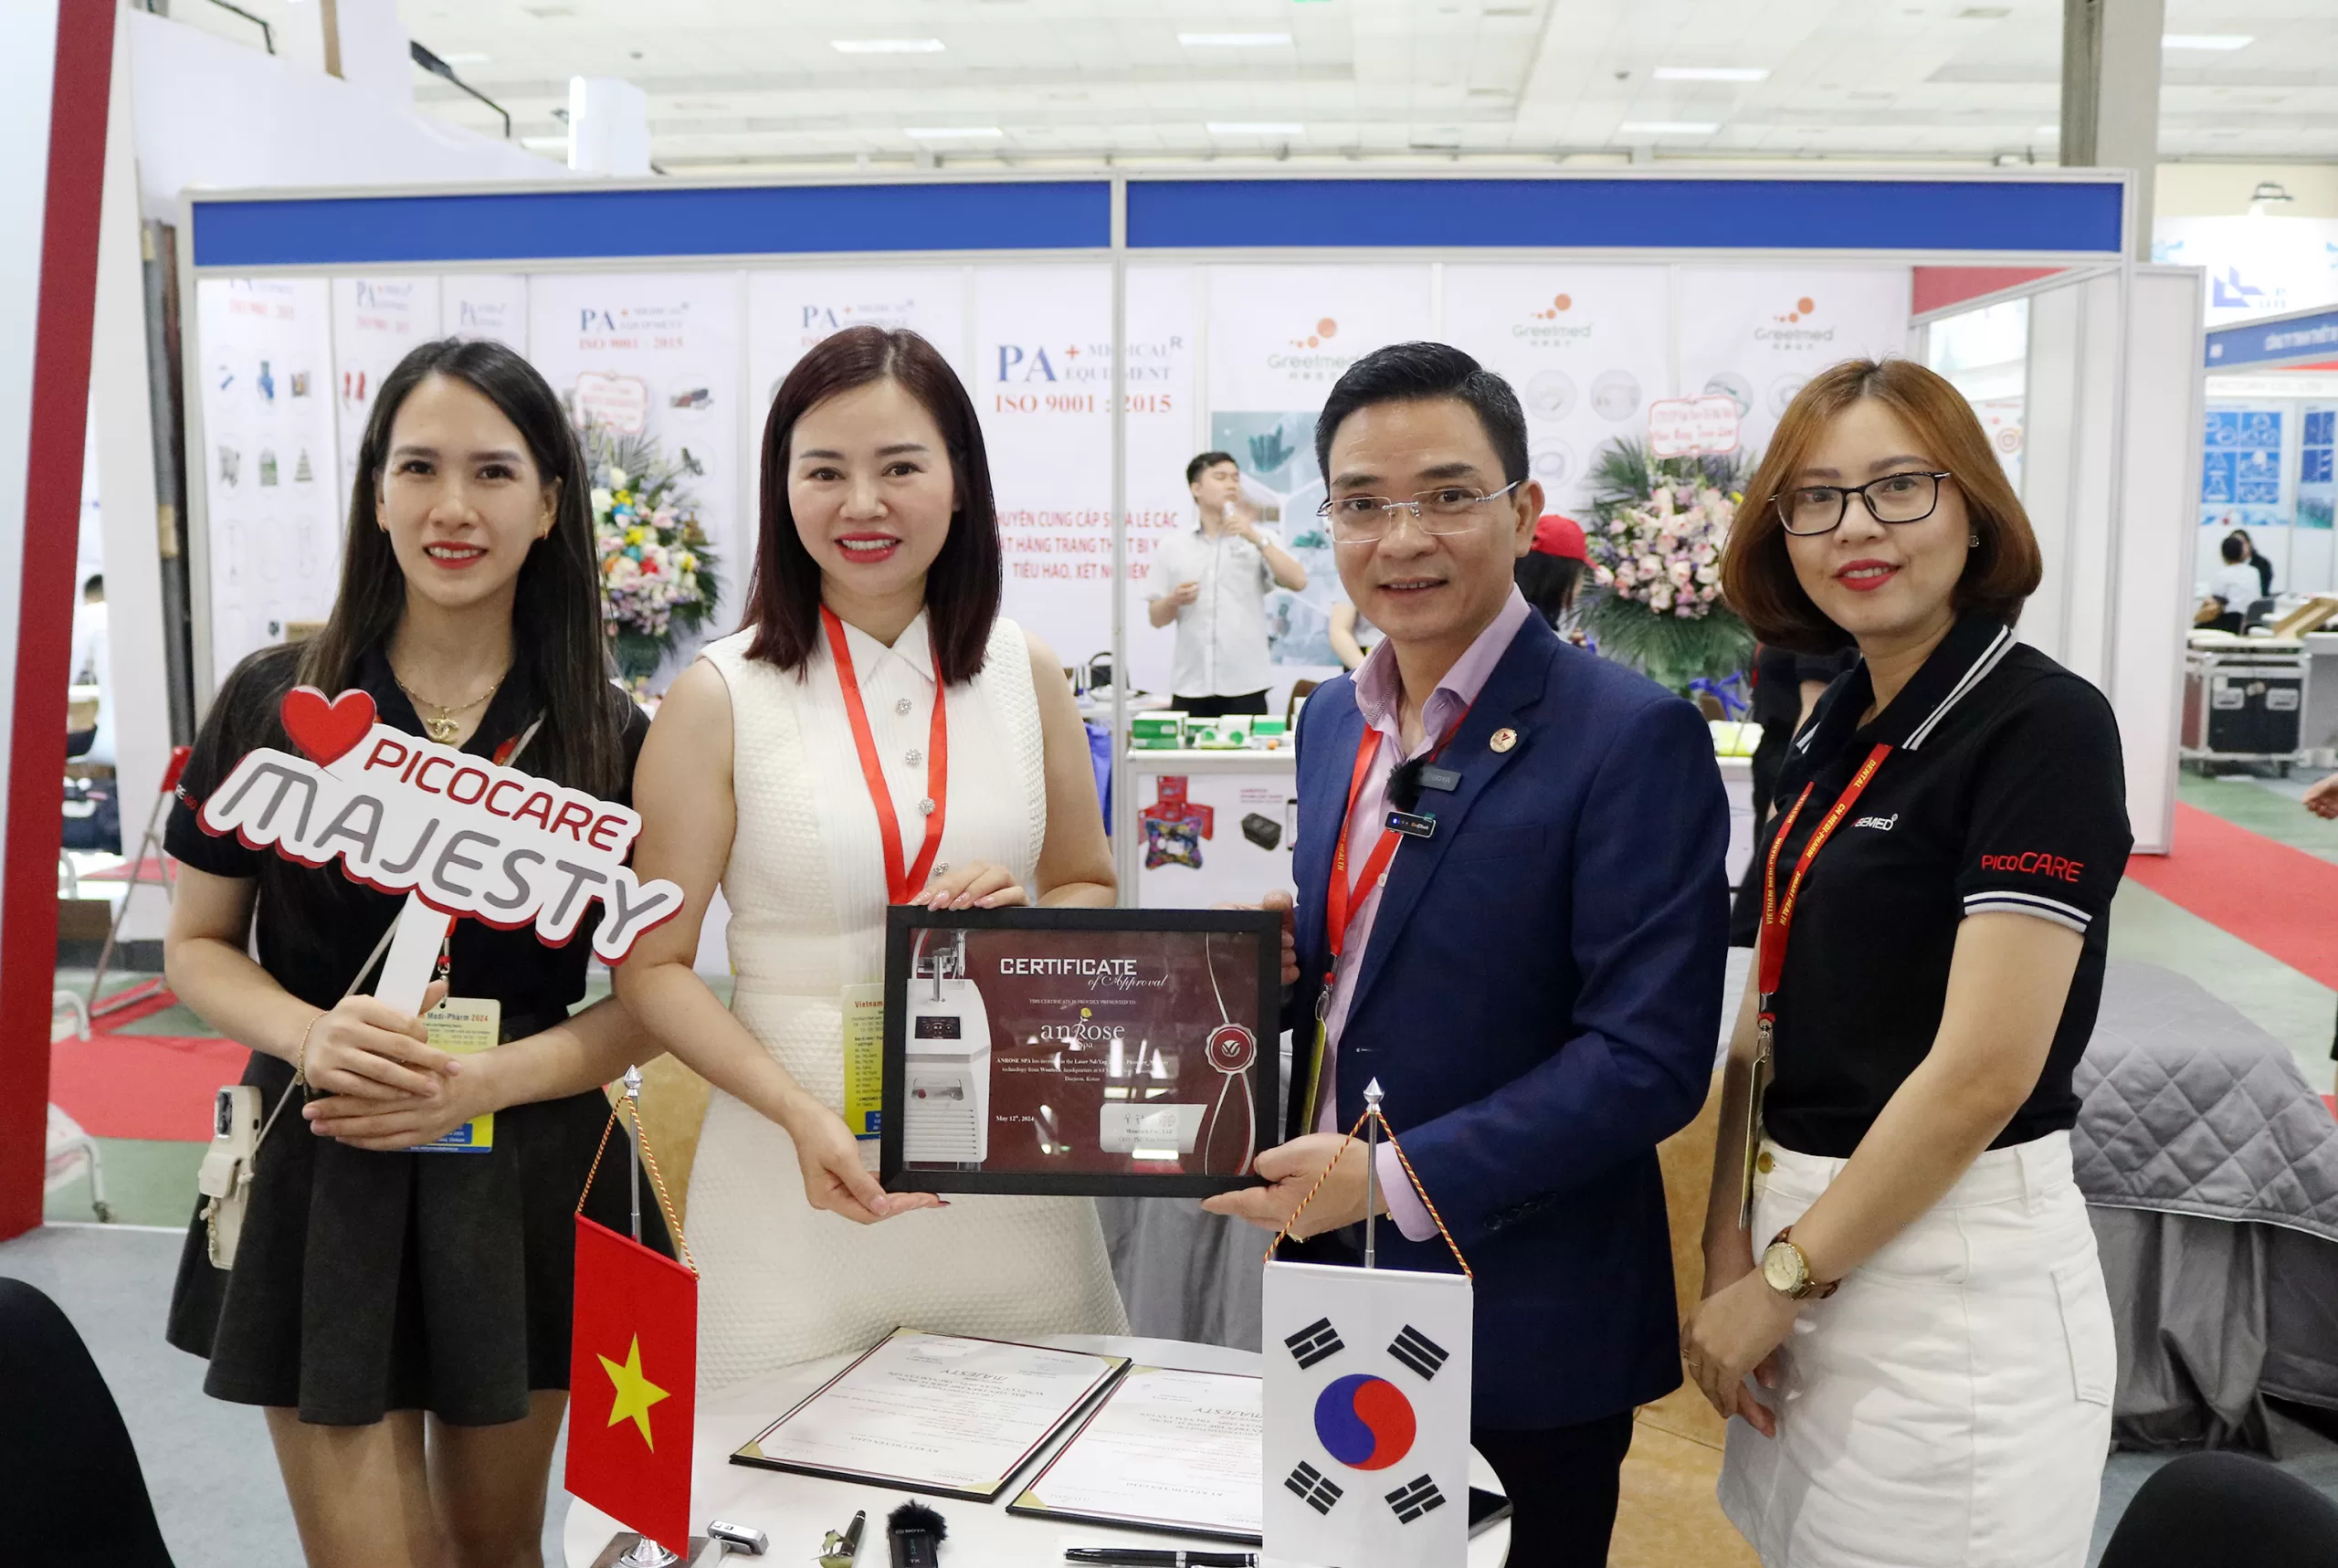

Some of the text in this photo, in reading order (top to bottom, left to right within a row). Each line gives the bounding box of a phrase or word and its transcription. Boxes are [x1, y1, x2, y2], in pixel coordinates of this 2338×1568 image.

[996, 343, 1059, 383] PA
[996, 395, 1037, 414] ISO
[1046, 395, 1094, 414] 9001
[1853, 759, 1877, 788] DENTAL
[363, 738, 629, 853] PICOCARE
[1805, 814, 1838, 858] MEDI-PHARM
[218, 762, 669, 945] MAJESTY
[1787, 869, 1802, 900] SMART
[1765, 889, 1775, 925] VIETNAM
[1000, 958, 1137, 975] CERTIFICATE
[1101, 973, 1169, 991] Approval
[996, 1115, 1008, 1123] May
